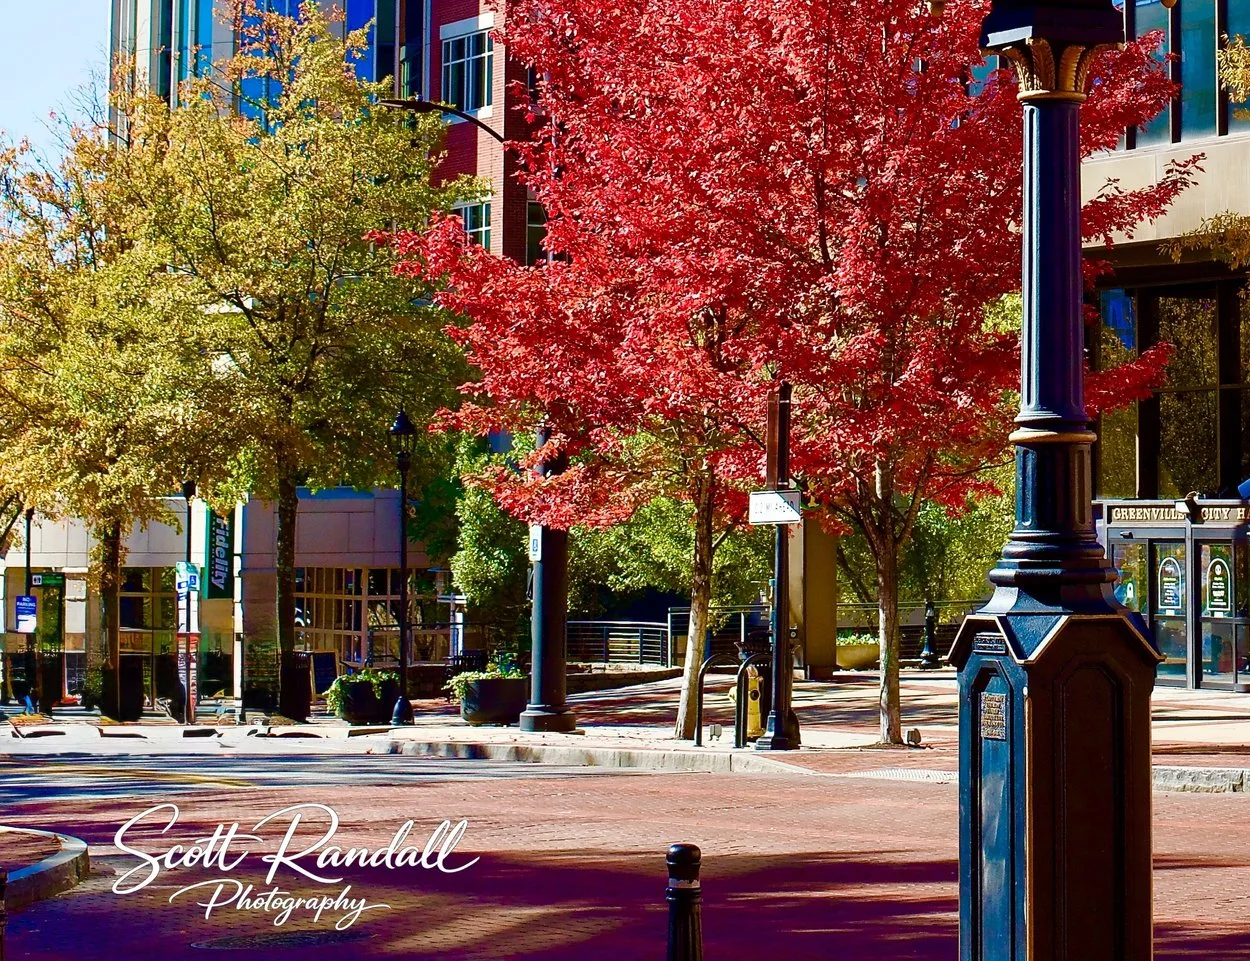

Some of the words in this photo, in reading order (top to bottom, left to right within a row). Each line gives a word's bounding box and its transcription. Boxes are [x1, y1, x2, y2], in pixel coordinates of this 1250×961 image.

[1113, 507, 1186, 520] GREENVILLE
[1201, 507, 1230, 521] CITY
[211, 518, 230, 590] Fidelity
